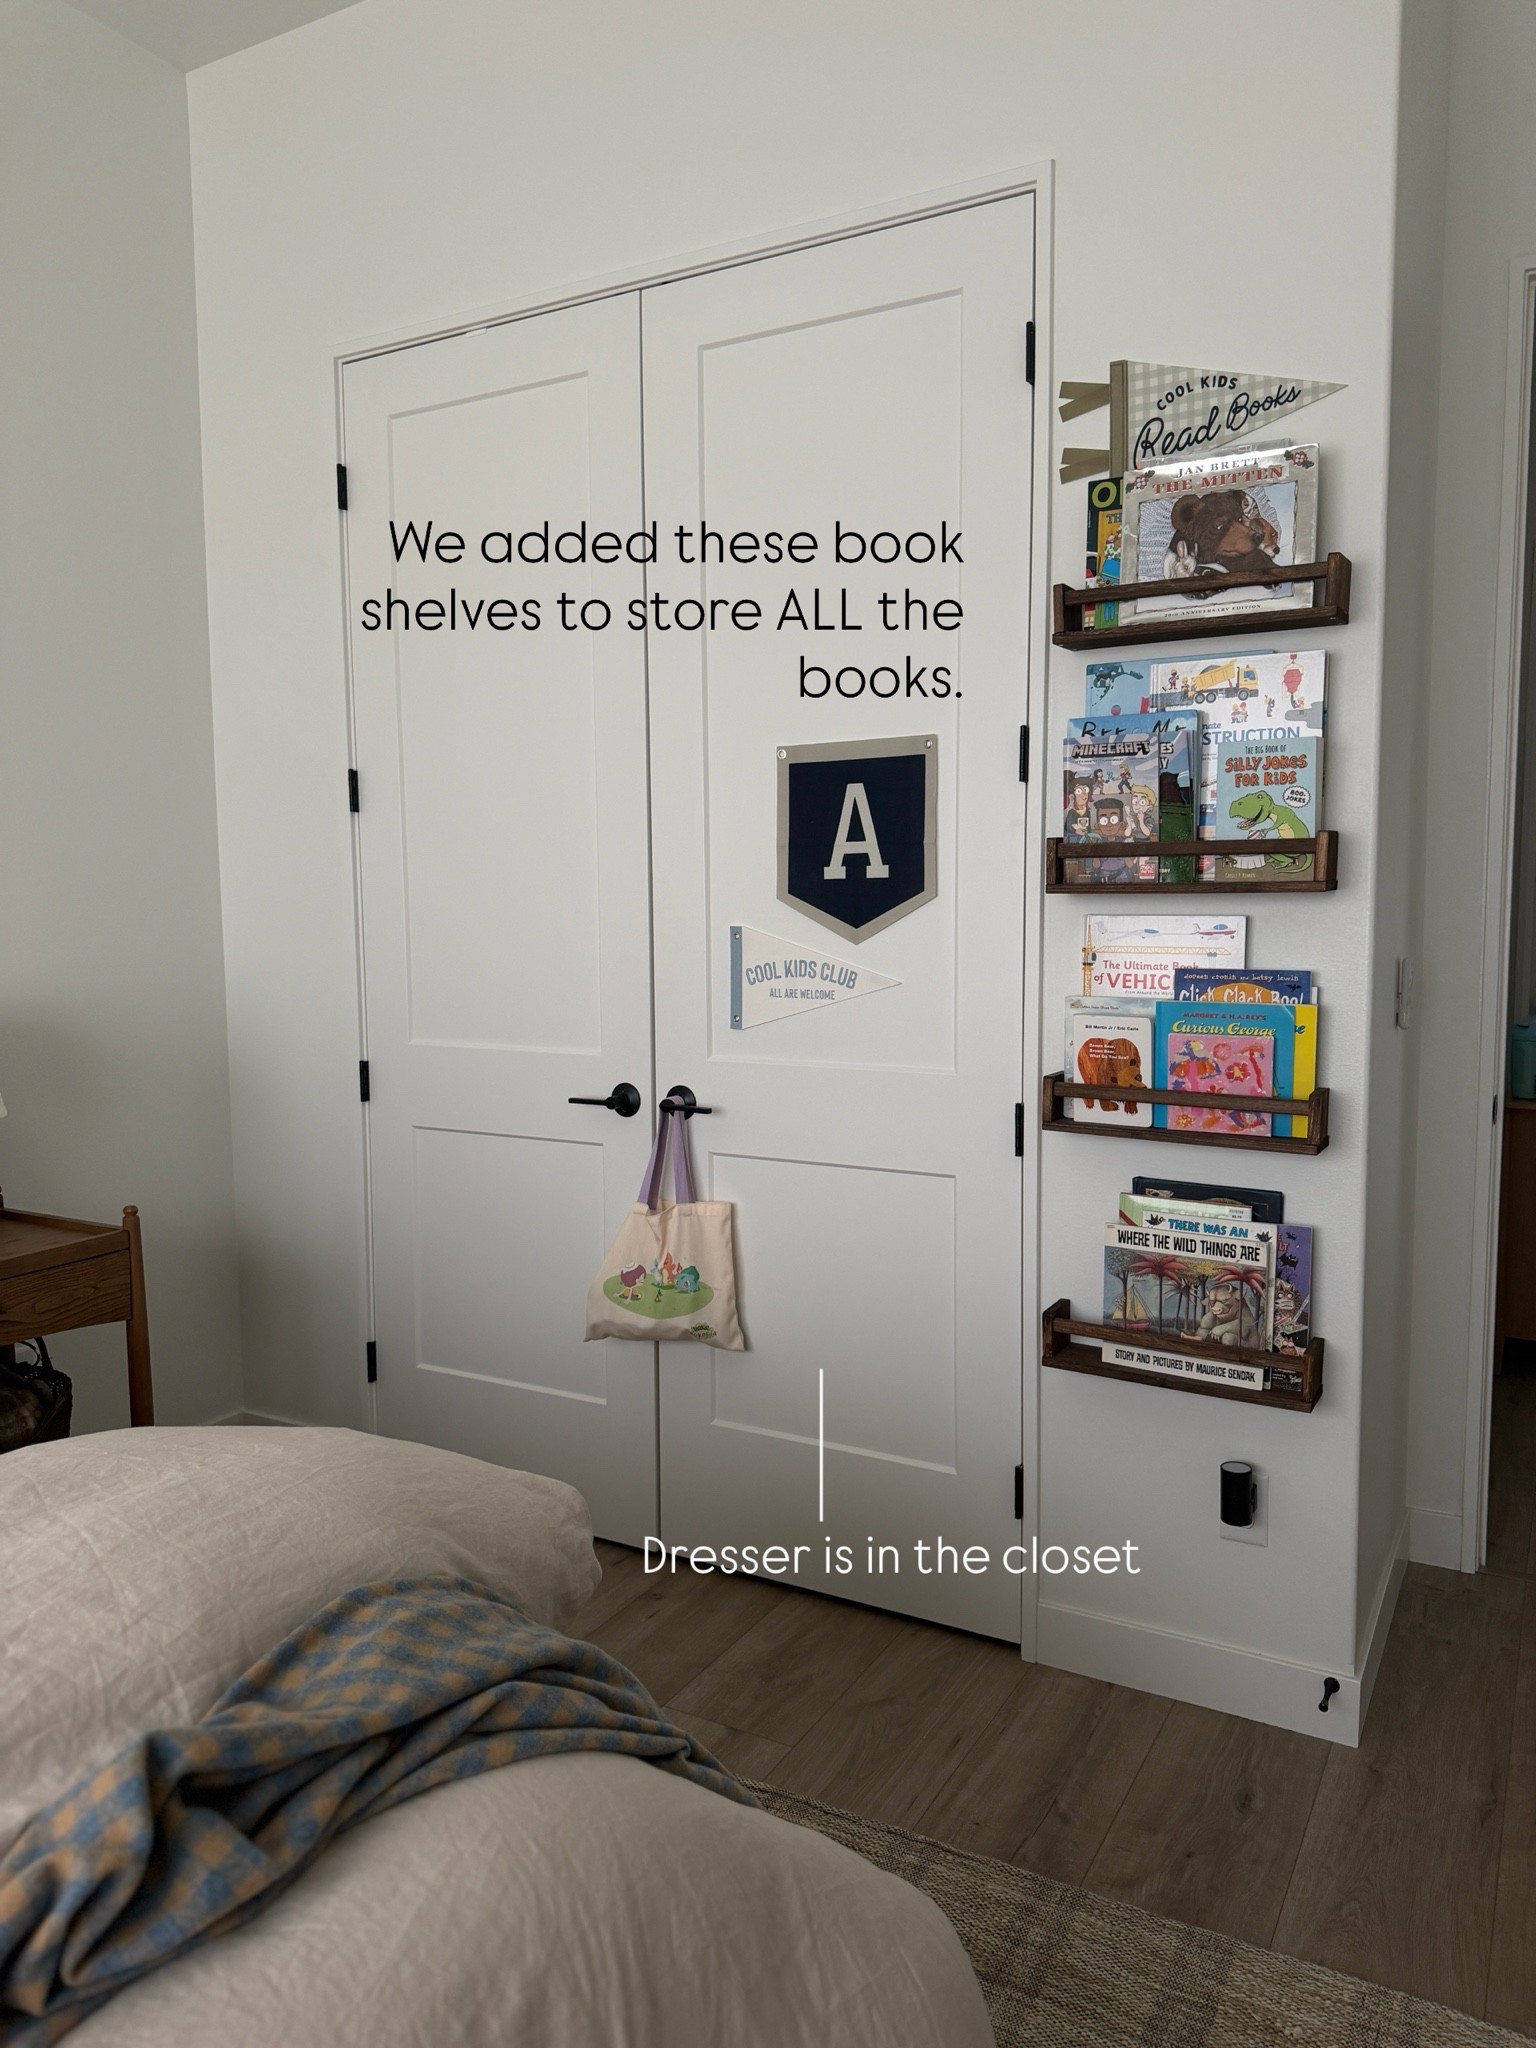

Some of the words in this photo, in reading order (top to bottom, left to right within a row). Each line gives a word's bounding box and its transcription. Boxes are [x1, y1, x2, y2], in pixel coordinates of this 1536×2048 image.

[1157, 382, 1194, 410] COOL
[1201, 375, 1238, 389] KIDS
[1133, 405, 1222, 470] Read
[1226, 384, 1302, 431] Books
[1176, 464, 1204, 478] JAN
[1211, 457, 1261, 472] BRETT
[1153, 479, 1193, 495] THE
[1201, 466, 1284, 488] MITTEN
[1202, 726, 1300, 745] STRUCTION
[1072, 740, 1150, 759] MINECRAFT
[1265, 744, 1279, 754] BOOK
[1279, 744, 1287, 753] OF
[1262, 753, 1309, 770] JOKES
[1234, 772, 1260, 788] FOR
[823, 782, 890, 880] A
[745, 961, 782, 986] COOL
[784, 959, 817, 979] KIDS
[819, 962, 858, 990] CLUB
[1103, 959, 1121, 970] The
[1124, 960, 1169, 971] Ultimate
[1094, 972, 1105, 985] of
[1106, 973, 1174, 991] VEHIC
[1252, 973, 1273, 983] betsy
[1277, 974, 1299, 982] lewin
[769, 987, 783, 999] ALL
[784, 988, 799, 999] ARE
[800, 989, 836, 1000] WELCOME
[1172, 1019, 1225, 1034] Curious
[1227, 1022, 1277, 1037] George
[1168, 1218, 1199, 1233] THERE
[1203, 1223, 1227, 1236] WAS
[1229, 1226, 1249, 1238] AN
[1117, 1229, 1150, 1247] WHERE
[1152, 1234, 1170, 1250] THE
[1173, 1236, 1197, 1254] WILD
[1200, 1240, 1237, 1259] THINGS
[1240, 1245, 1261, 1262] ARE
[1115, 1348, 1135, 1362] STORY
[1136, 1352, 1150, 1364] AND
[1152, 1355, 1183, 1371] PICTURES
[1185, 1361, 1194, 1372] BY
[1196, 1363, 1227, 1378] MAURICE
[1228, 1369, 1256, 1383] SENDAK
